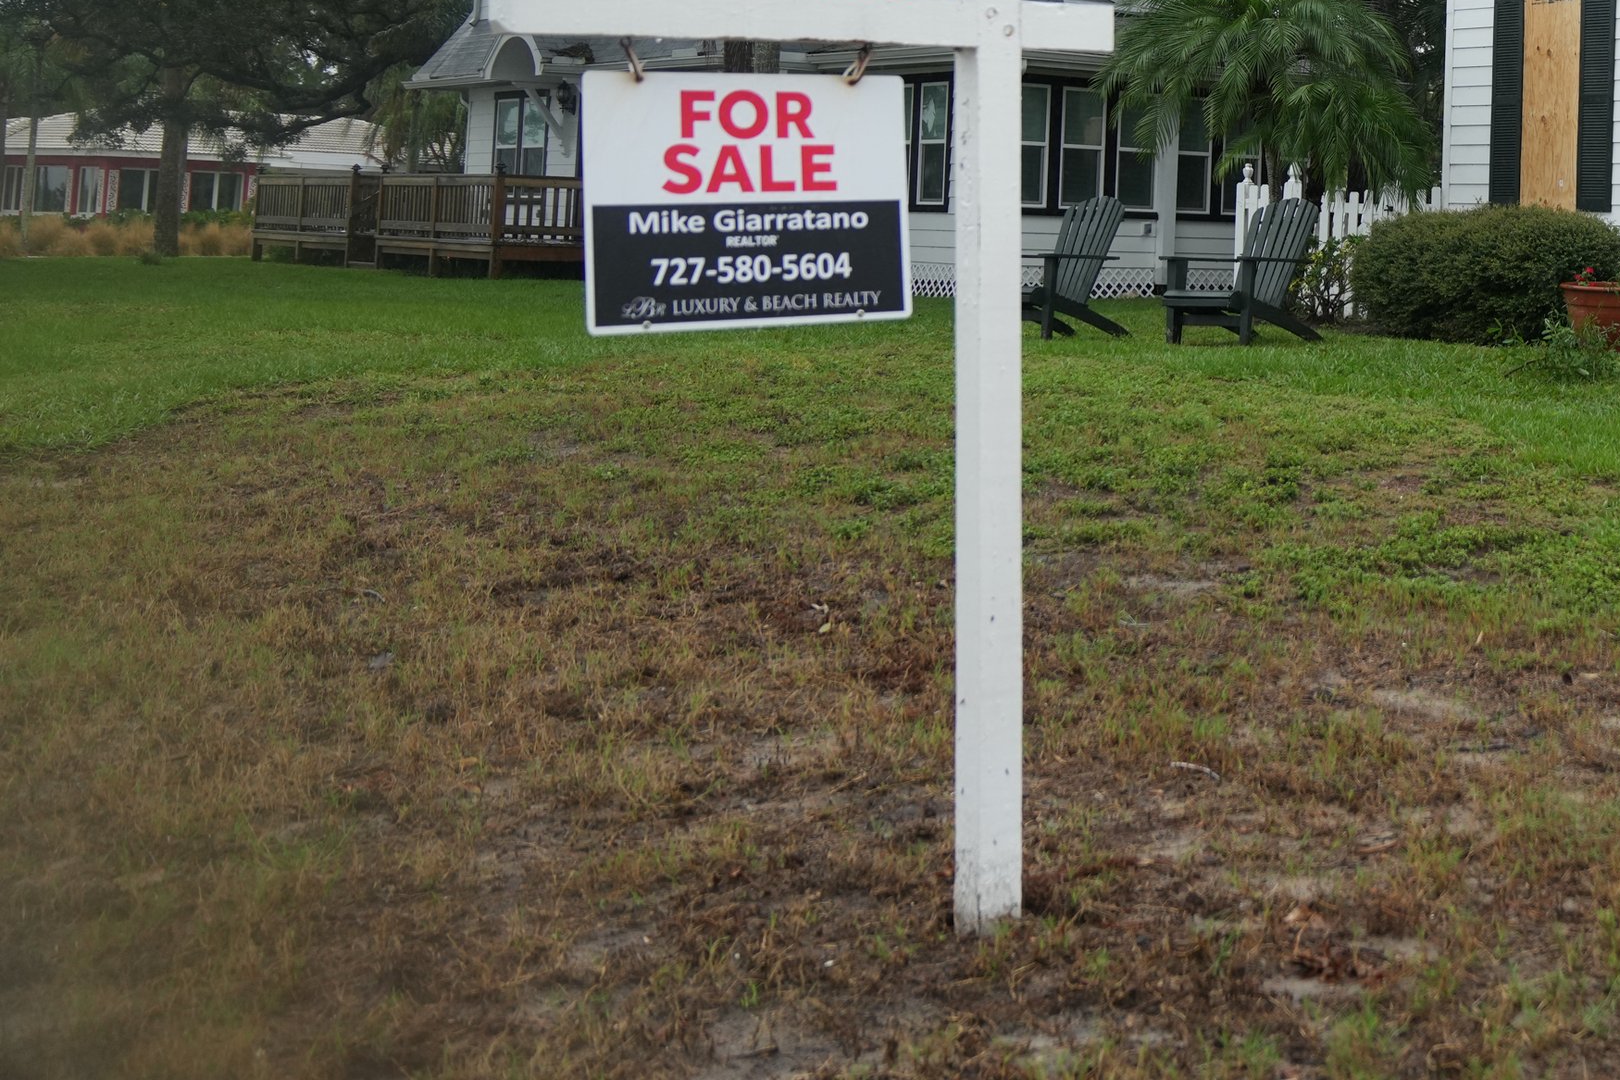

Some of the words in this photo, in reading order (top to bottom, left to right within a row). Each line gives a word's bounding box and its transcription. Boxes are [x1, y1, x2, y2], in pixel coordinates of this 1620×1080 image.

[680, 90, 815, 139] FOR
[662, 143, 838, 195] SALE
[628, 209, 706, 235] Mike
[712, 208, 870, 233] Giarratano
[650, 251, 853, 287] 727-580-5604
[672, 296, 741, 316] LUXURY
[744, 295, 759, 312] &
[762, 293, 817, 311] BEACH
[823, 290, 882, 309] REALTY
